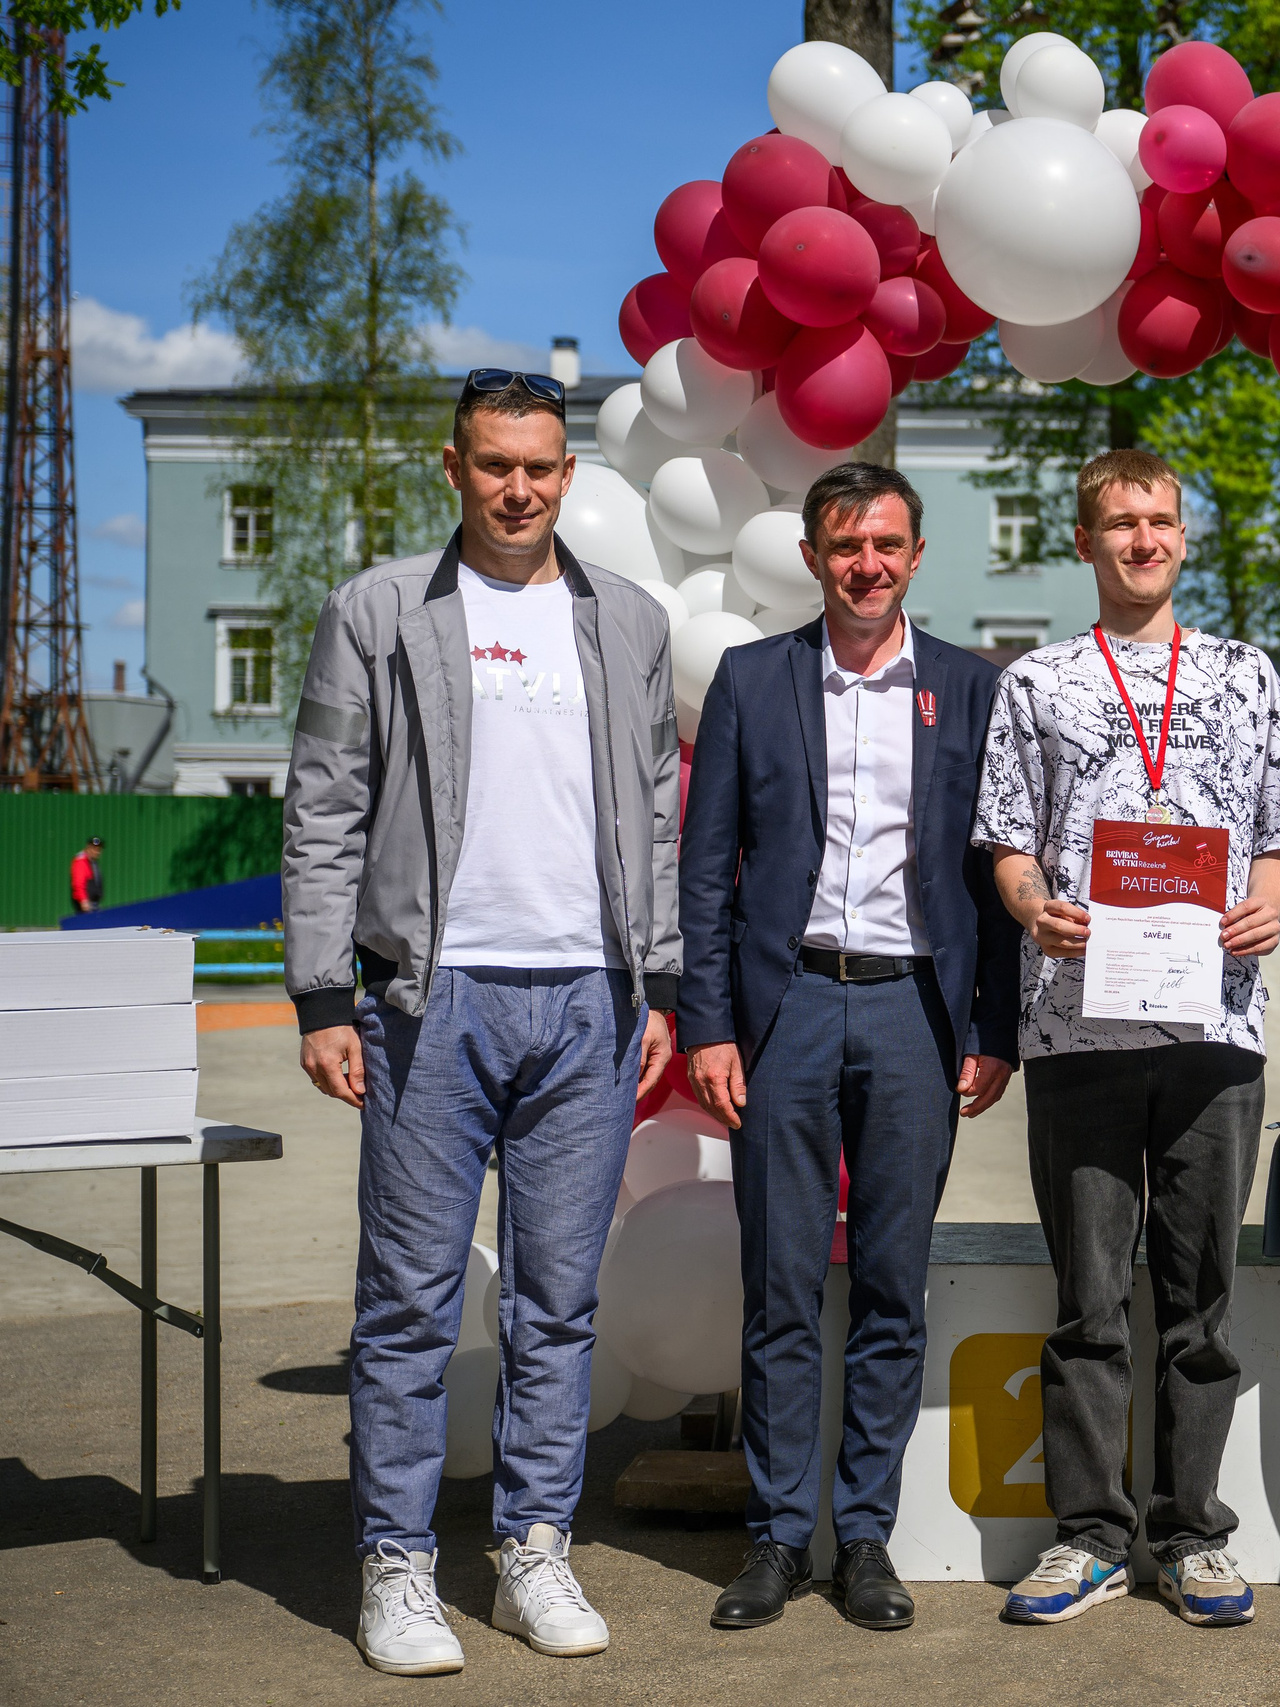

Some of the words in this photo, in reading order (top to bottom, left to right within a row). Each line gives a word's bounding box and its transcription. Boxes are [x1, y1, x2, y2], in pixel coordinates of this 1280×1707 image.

[1104, 702, 1129, 715] GO
[1135, 702, 1202, 716] WHERE
[1107, 734, 1157, 749] MOT
[1121, 876, 1200, 895] PATEICĪBA
[1143, 930, 1172, 940] SAVĒJIE
